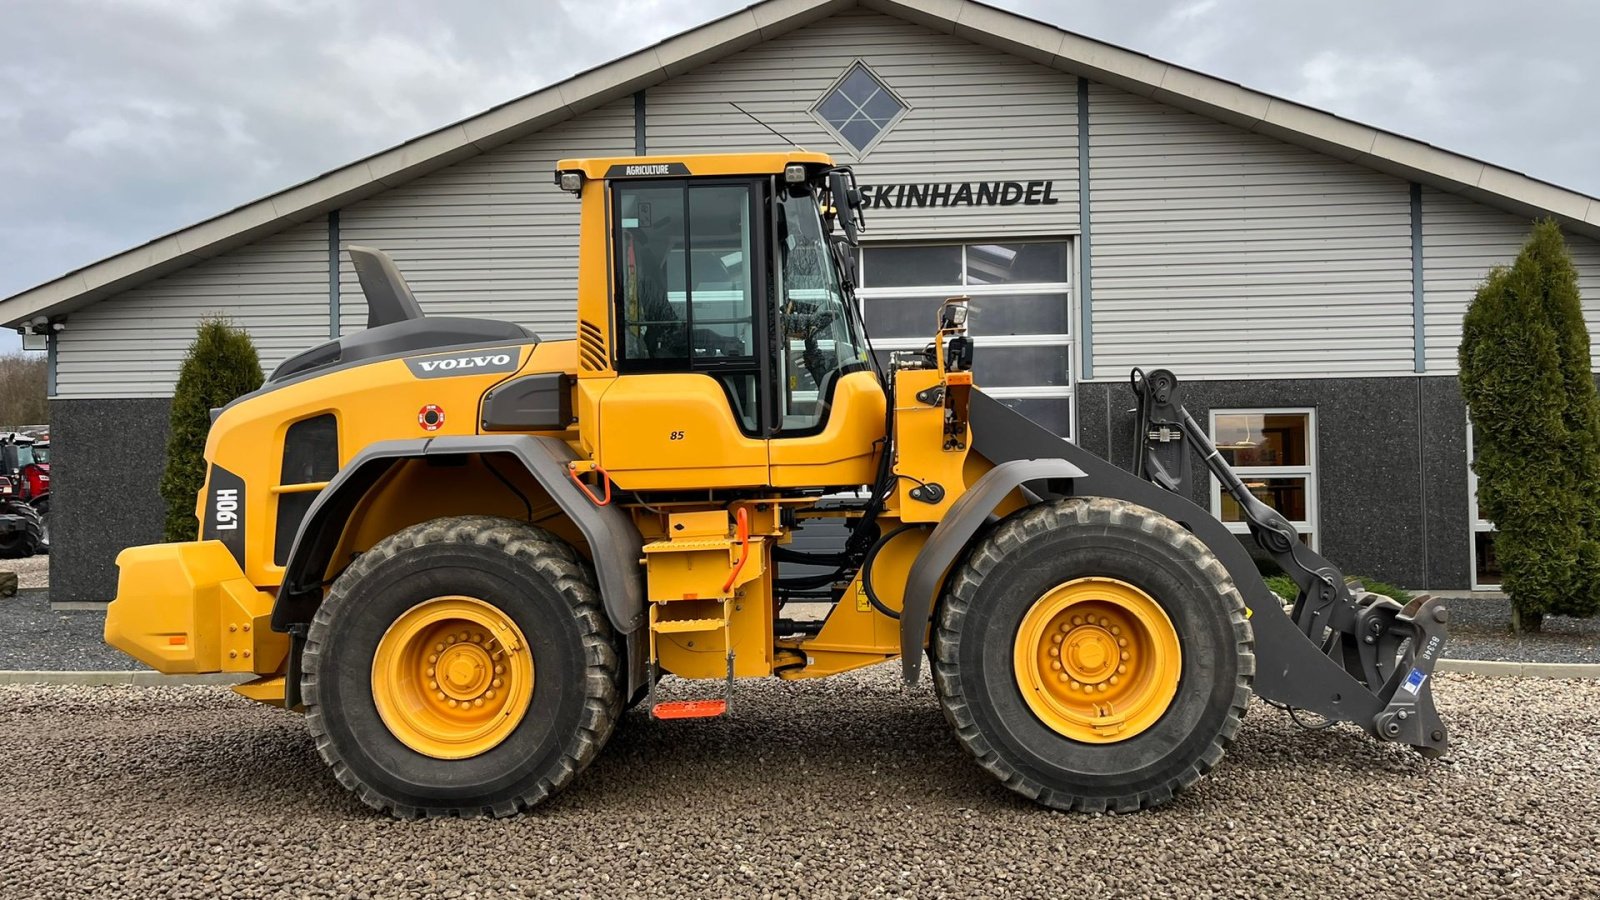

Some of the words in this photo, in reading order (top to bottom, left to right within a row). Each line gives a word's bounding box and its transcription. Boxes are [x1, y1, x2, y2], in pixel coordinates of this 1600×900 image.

[625, 164, 669, 176] AGRICULTURE
[418, 354, 511, 372] VOLVO
[670, 430, 684, 440] 85
[216, 489, 238, 530] L90H
